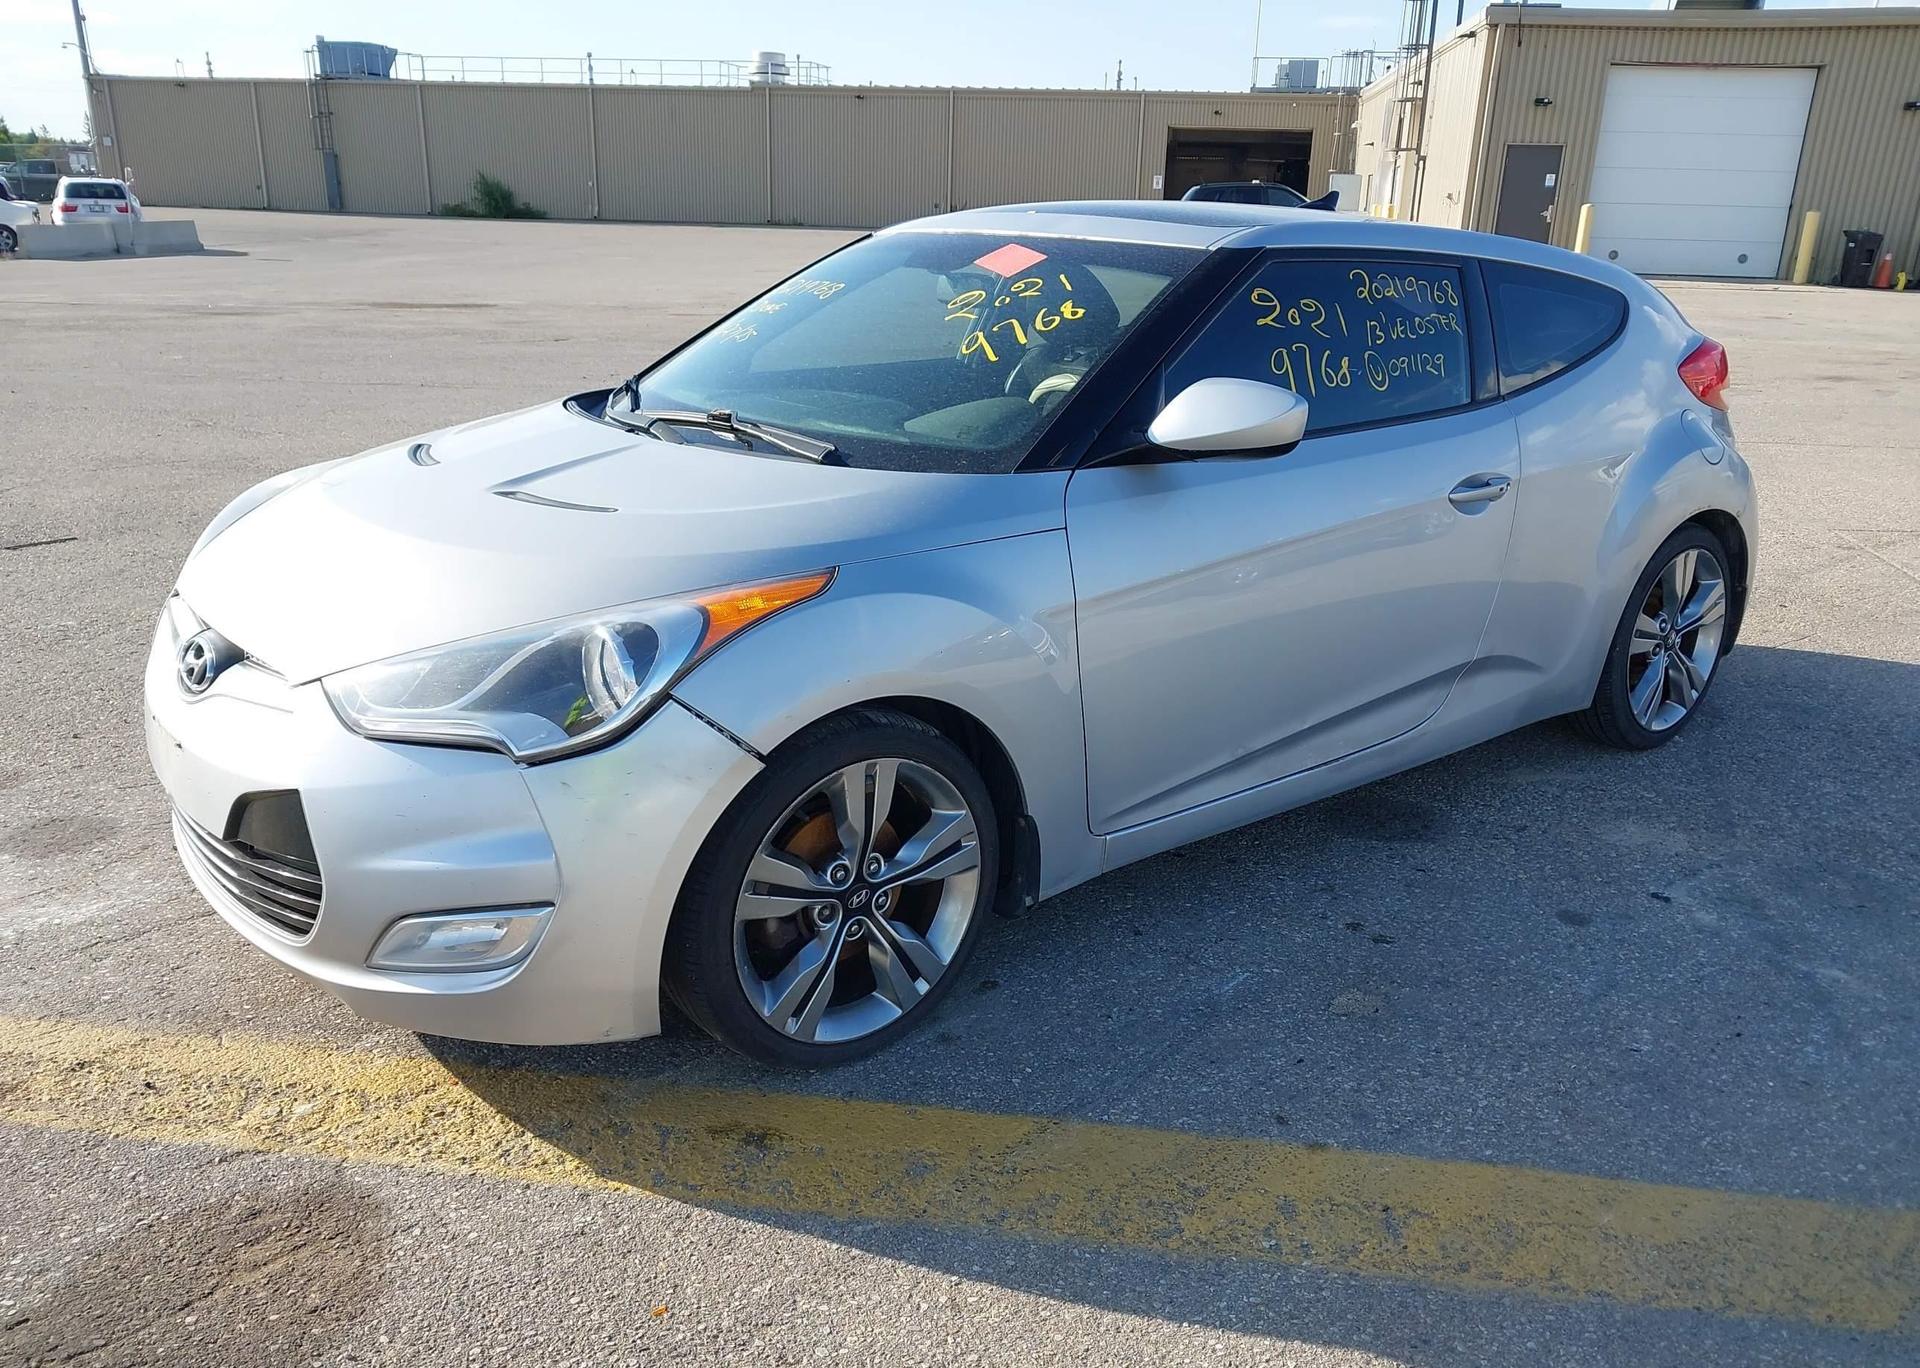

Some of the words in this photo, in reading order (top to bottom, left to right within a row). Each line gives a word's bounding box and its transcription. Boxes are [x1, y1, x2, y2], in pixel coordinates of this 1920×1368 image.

[944, 273, 1073, 321] 2021
[1251, 287, 1348, 338] 2021
[1349, 269, 1459, 307] 20219768
[961, 299, 1087, 363] 9768
[1270, 343, 1352, 398] 9768
